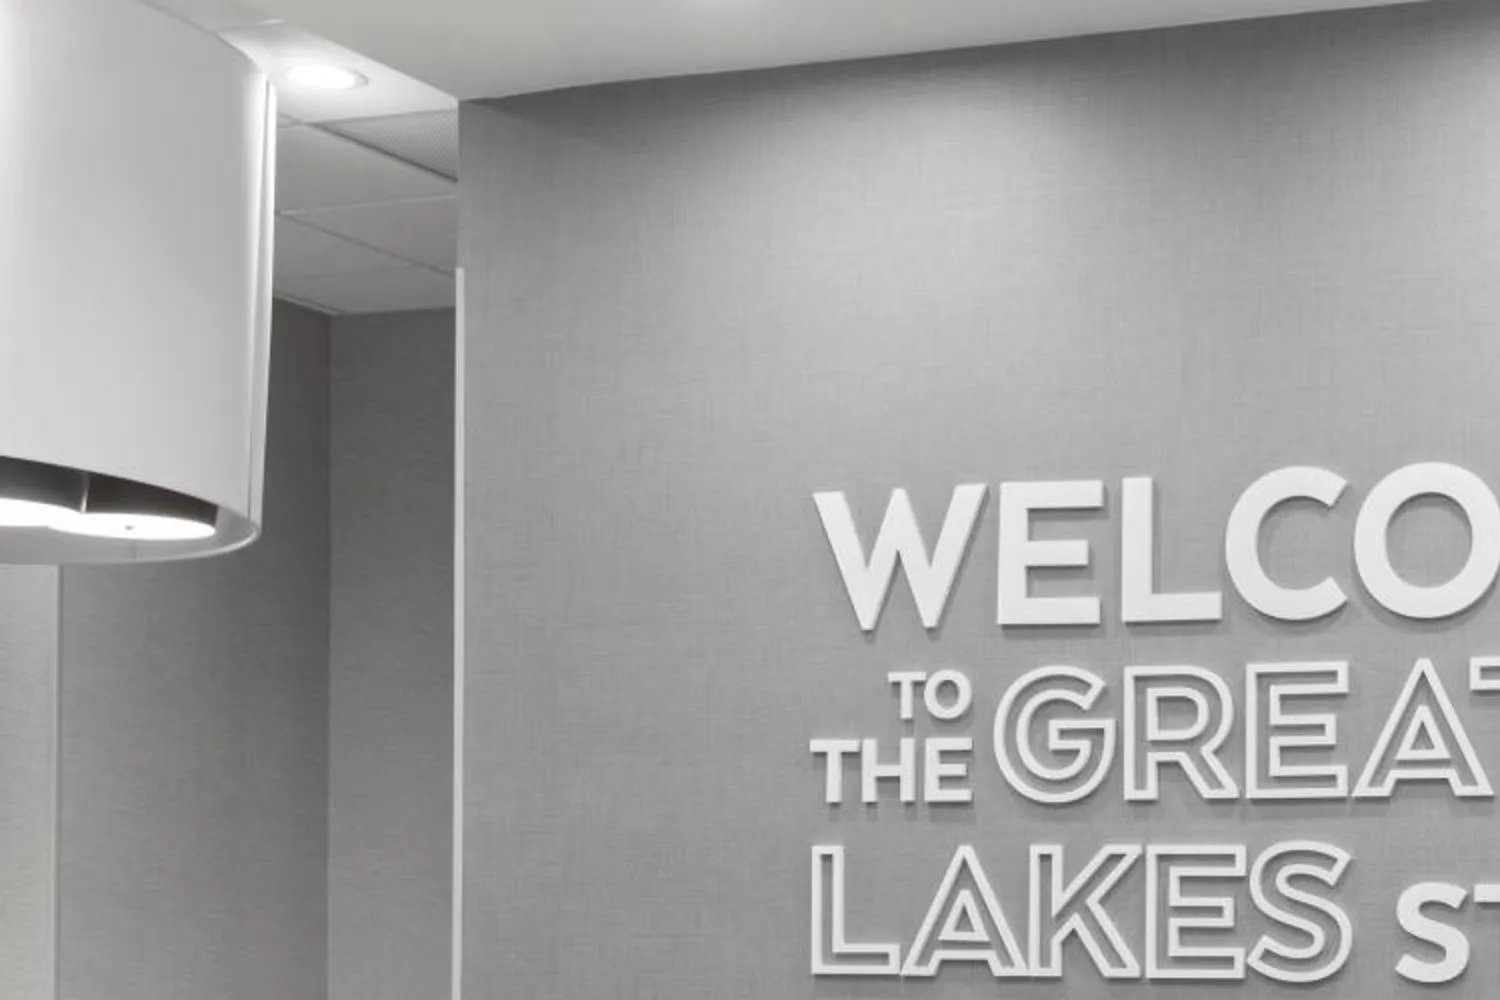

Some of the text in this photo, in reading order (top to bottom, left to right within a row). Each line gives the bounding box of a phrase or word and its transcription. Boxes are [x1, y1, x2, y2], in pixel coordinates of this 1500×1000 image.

[887, 669, 973, 720] TO
[809, 737, 974, 803] THE
[810, 840, 1354, 983] LAKES
